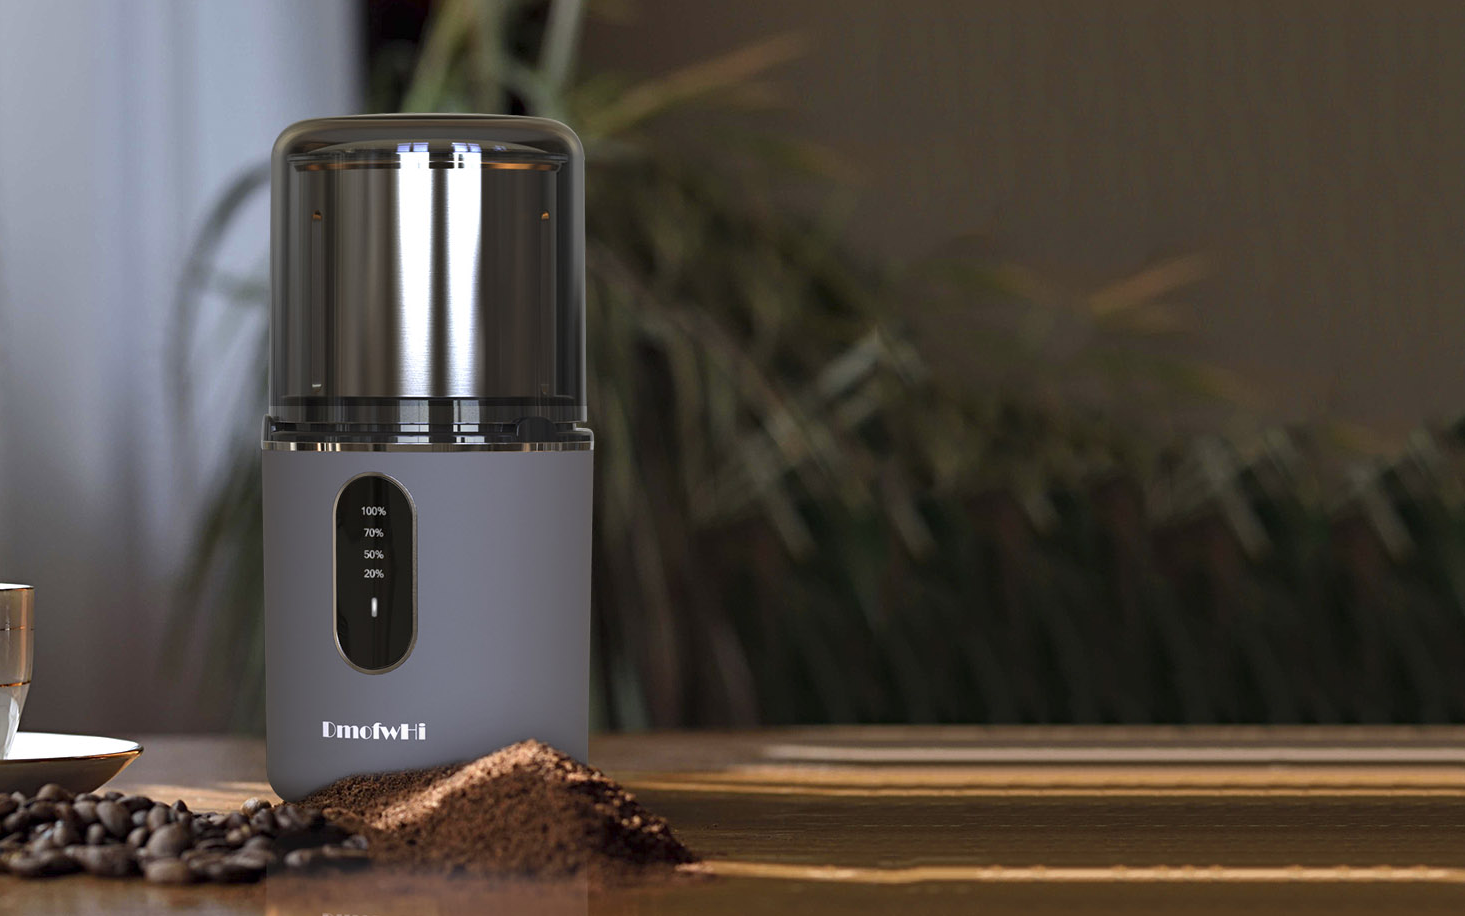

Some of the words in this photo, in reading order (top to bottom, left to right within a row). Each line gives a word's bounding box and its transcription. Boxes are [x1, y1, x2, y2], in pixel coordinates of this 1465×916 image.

[361, 506, 387, 516] 100%
[363, 528, 384, 538] 70%
[363, 549, 385, 559] 50%
[363, 568, 385, 578] 20%
[322, 721, 426, 740] DmofwHi
